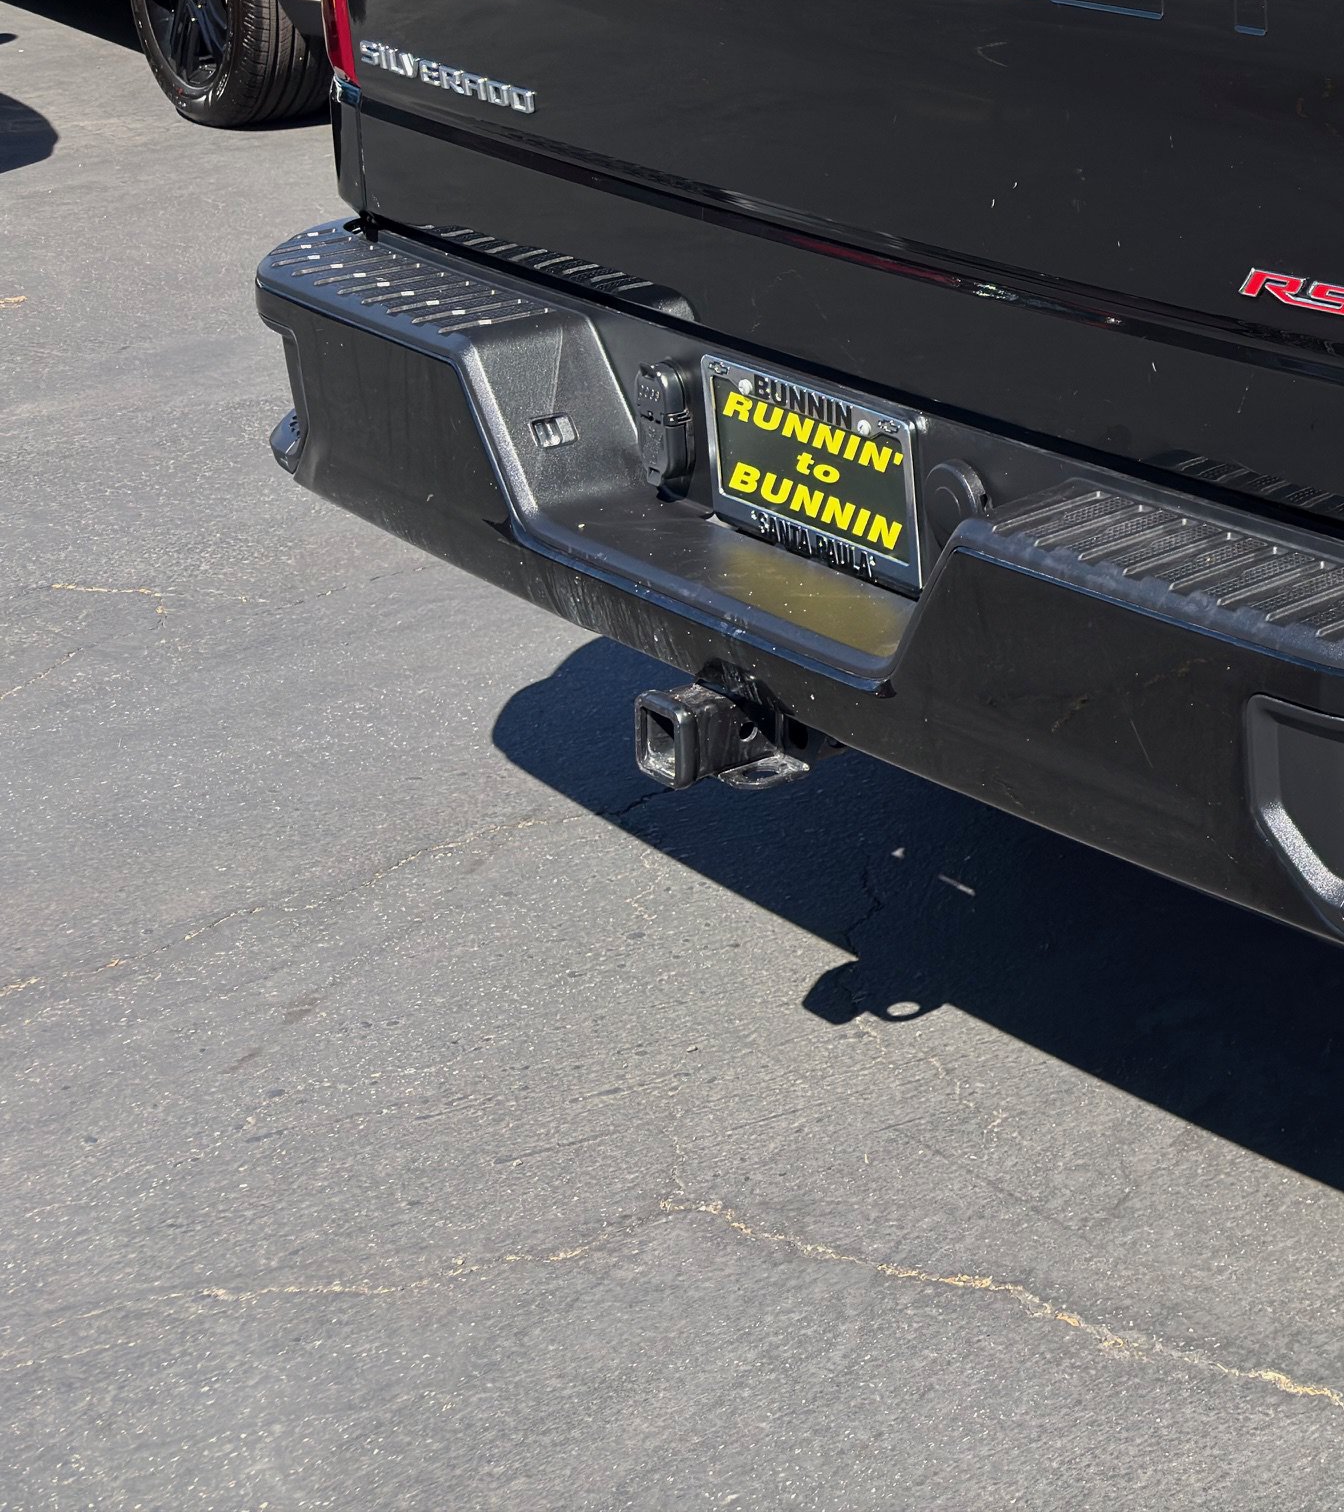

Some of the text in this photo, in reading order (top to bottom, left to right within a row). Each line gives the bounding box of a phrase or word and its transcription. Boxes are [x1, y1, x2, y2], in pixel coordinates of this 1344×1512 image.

[359, 39, 538, 114] SILVERADO
[722, 391, 904, 473] RUNNIN'
[753, 374, 853, 429] BUNNIN
[796, 452, 841, 484] to
[728, 461, 903, 550] BUNNIN
[757, 511, 812, 555] SANTA
